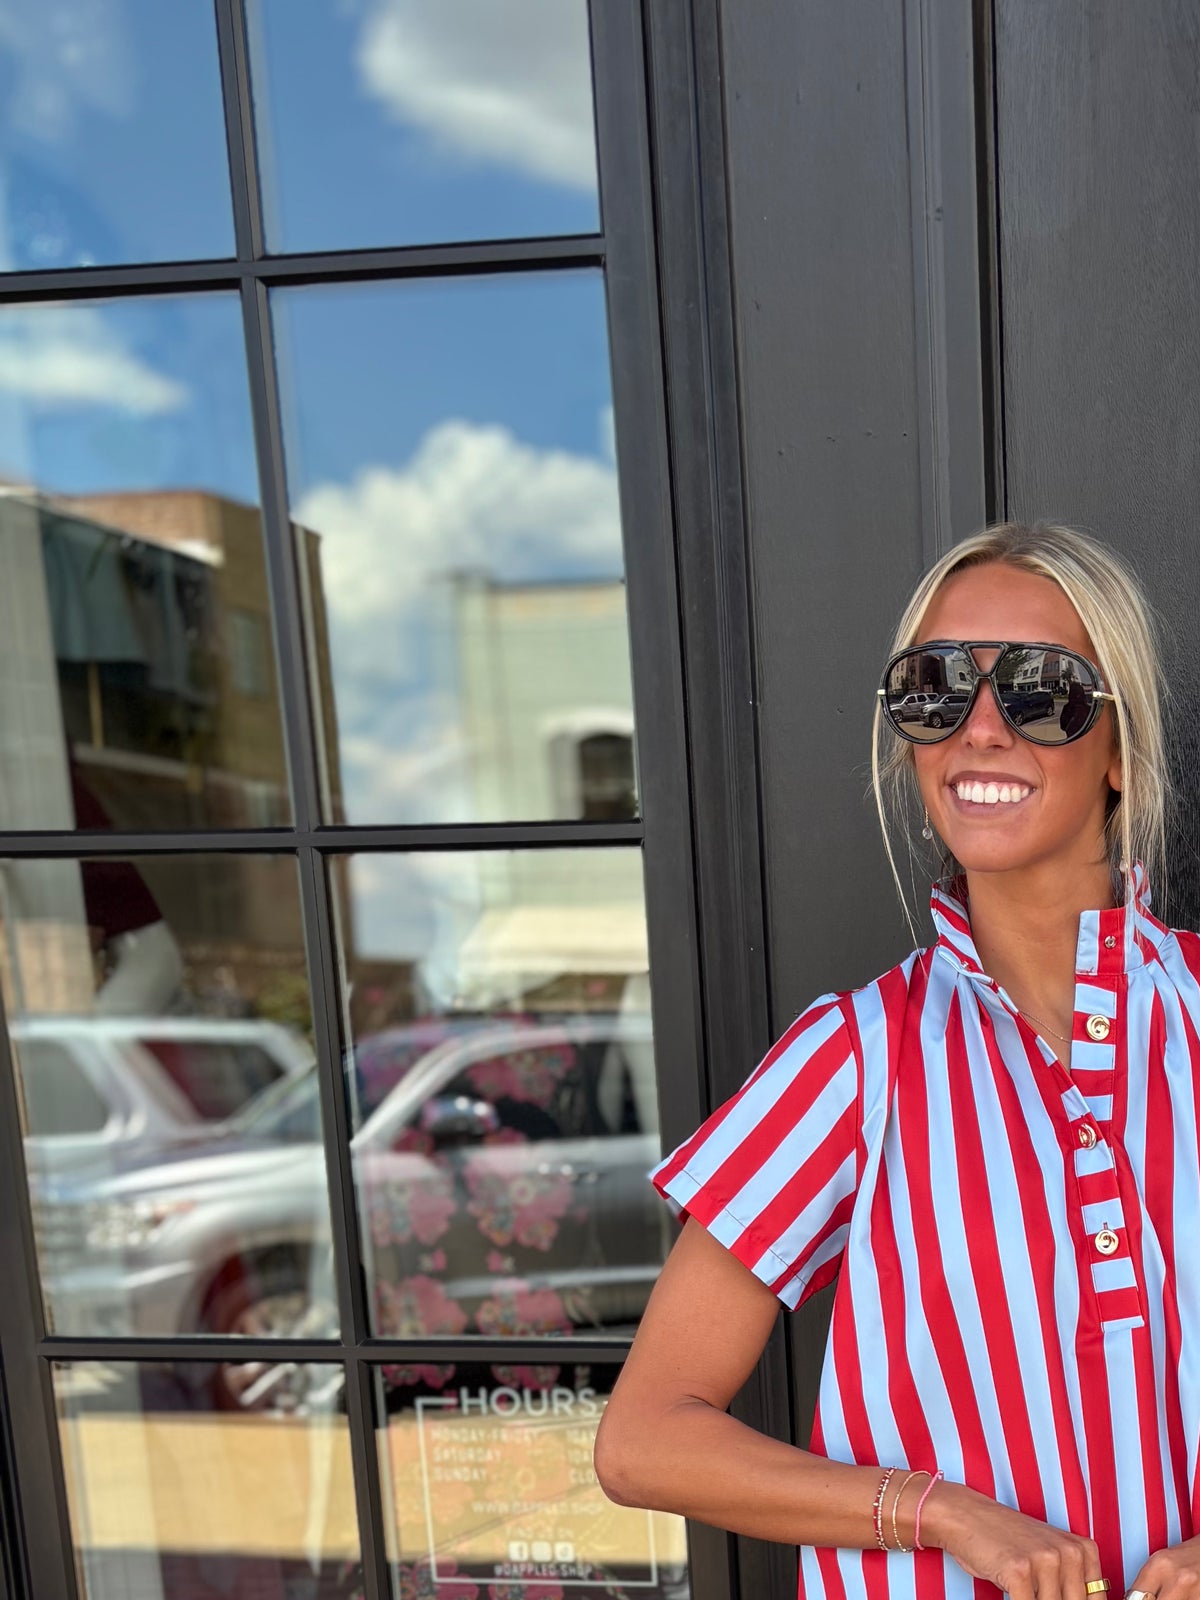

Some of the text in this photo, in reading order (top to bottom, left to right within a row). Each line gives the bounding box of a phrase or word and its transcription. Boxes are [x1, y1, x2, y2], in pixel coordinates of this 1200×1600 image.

[460, 1386, 597, 1416] HOURS
[433, 1447, 500, 1462] SATURDAY
[434, 1466, 487, 1482] SUNDAY
